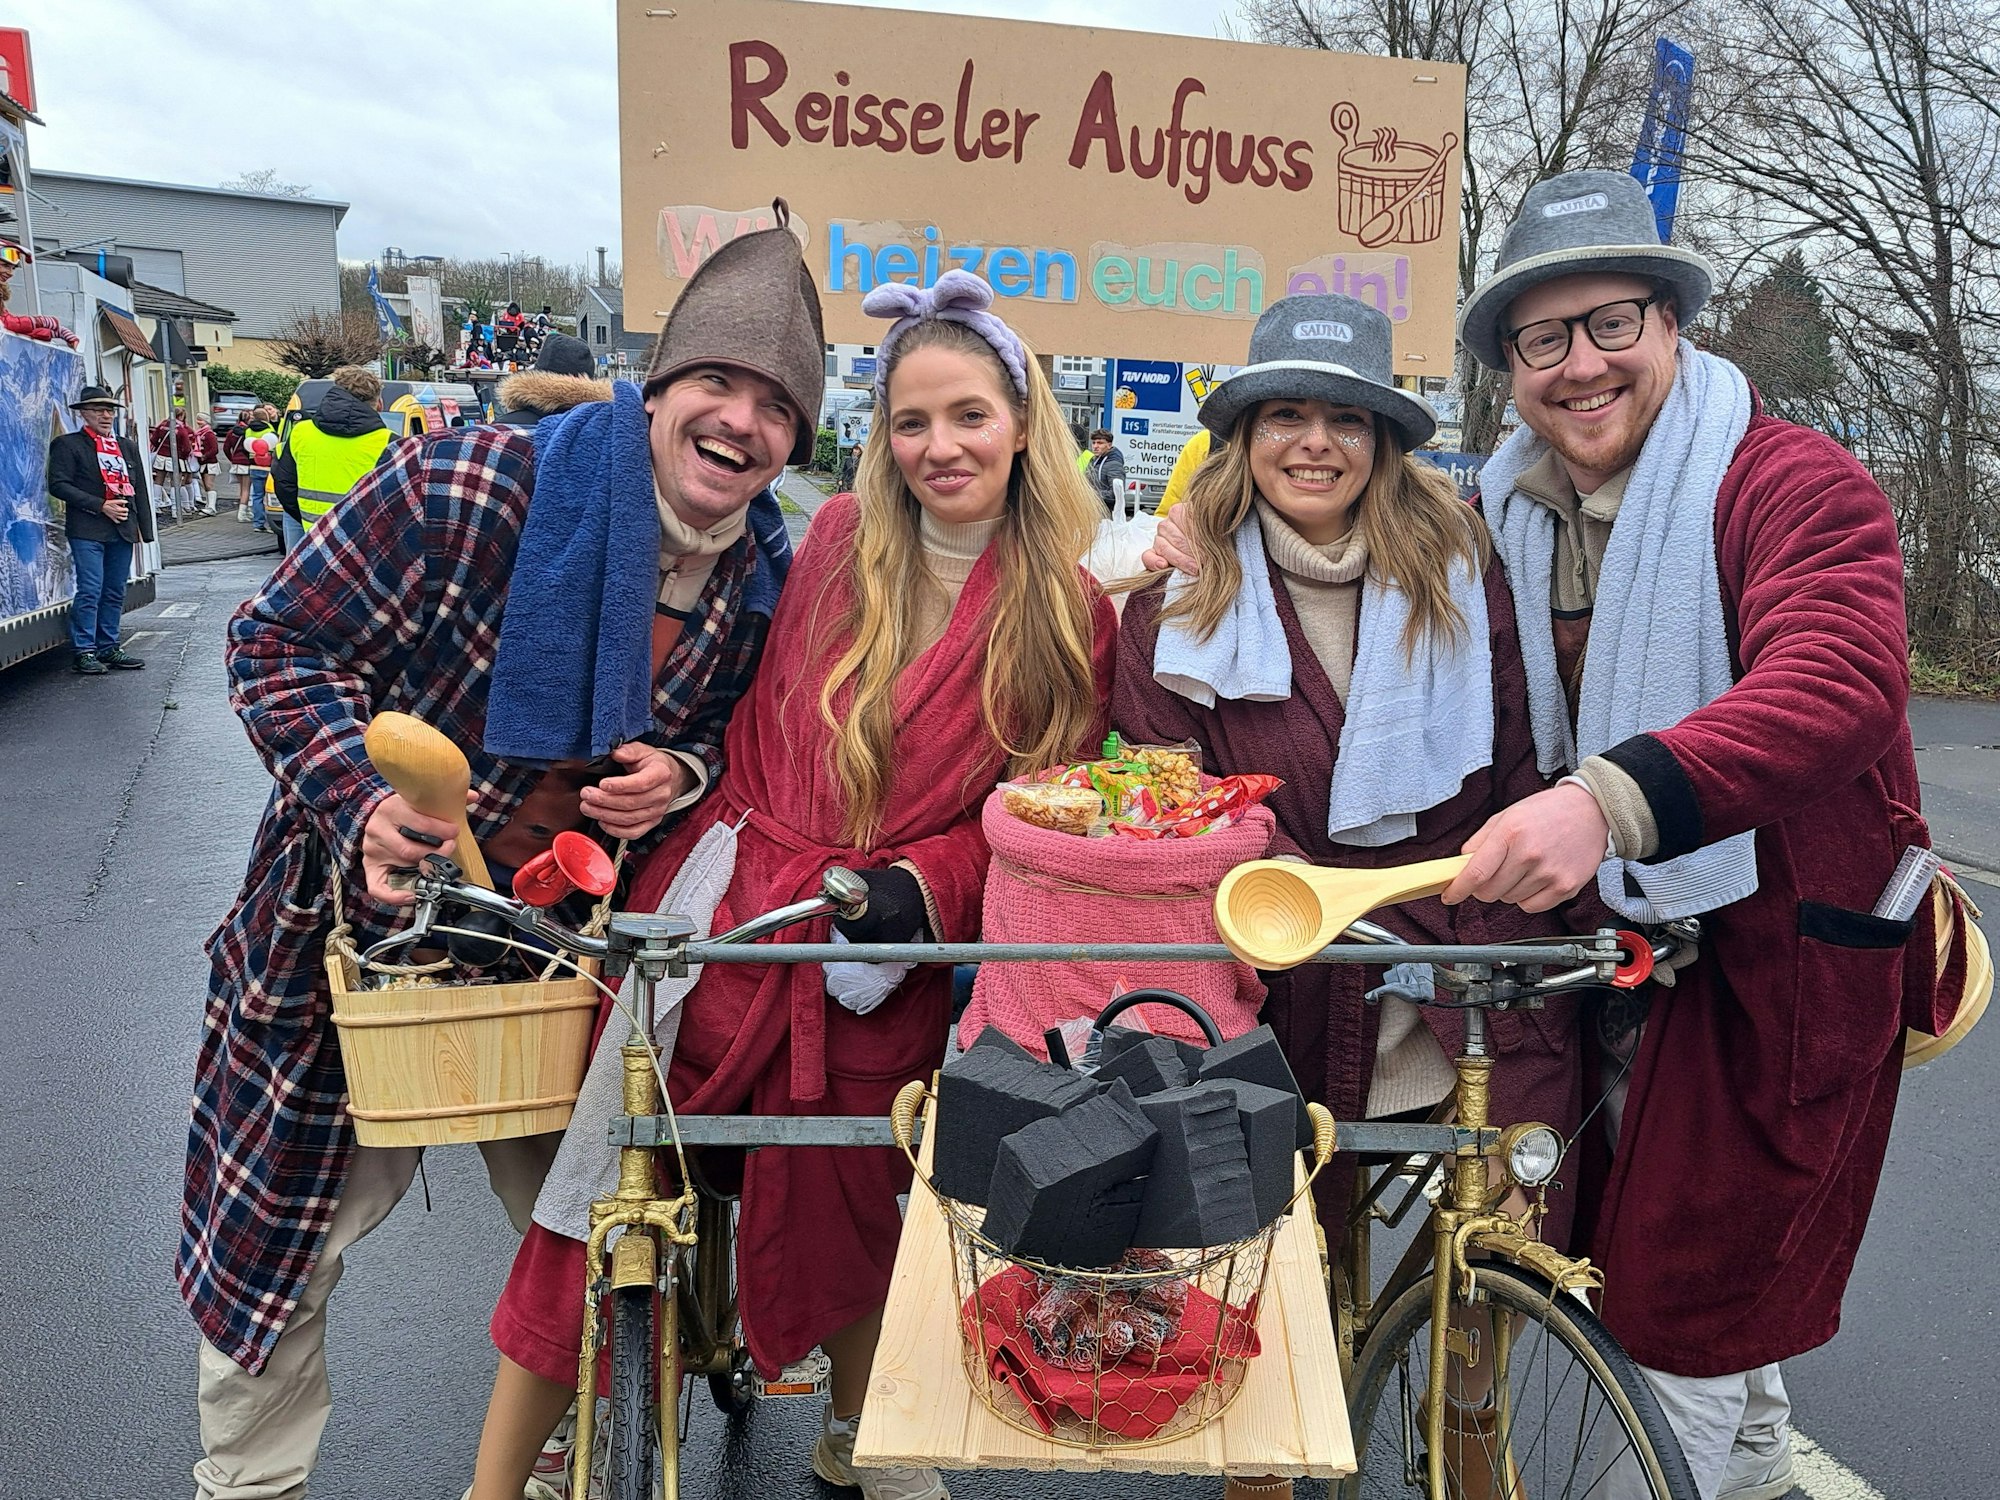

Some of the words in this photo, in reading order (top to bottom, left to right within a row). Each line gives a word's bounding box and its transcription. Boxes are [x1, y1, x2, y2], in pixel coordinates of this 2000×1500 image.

[728, 40, 1040, 164] Reisseler
[1068, 70, 1314, 204] Aufguss
[1550, 197, 1603, 214] SAUNA
[829, 223, 1076, 301] heizen
[1092, 249, 1263, 314] euch
[1300, 323, 1349, 340] SAUNA
[1141, 373, 1171, 384] NORD
[1124, 420, 1140, 432] IfS
[1129, 438, 1185, 455] Schadeng
[1140, 452, 1178, 467] Wertg
[1123, 464, 1173, 476] echnisch
